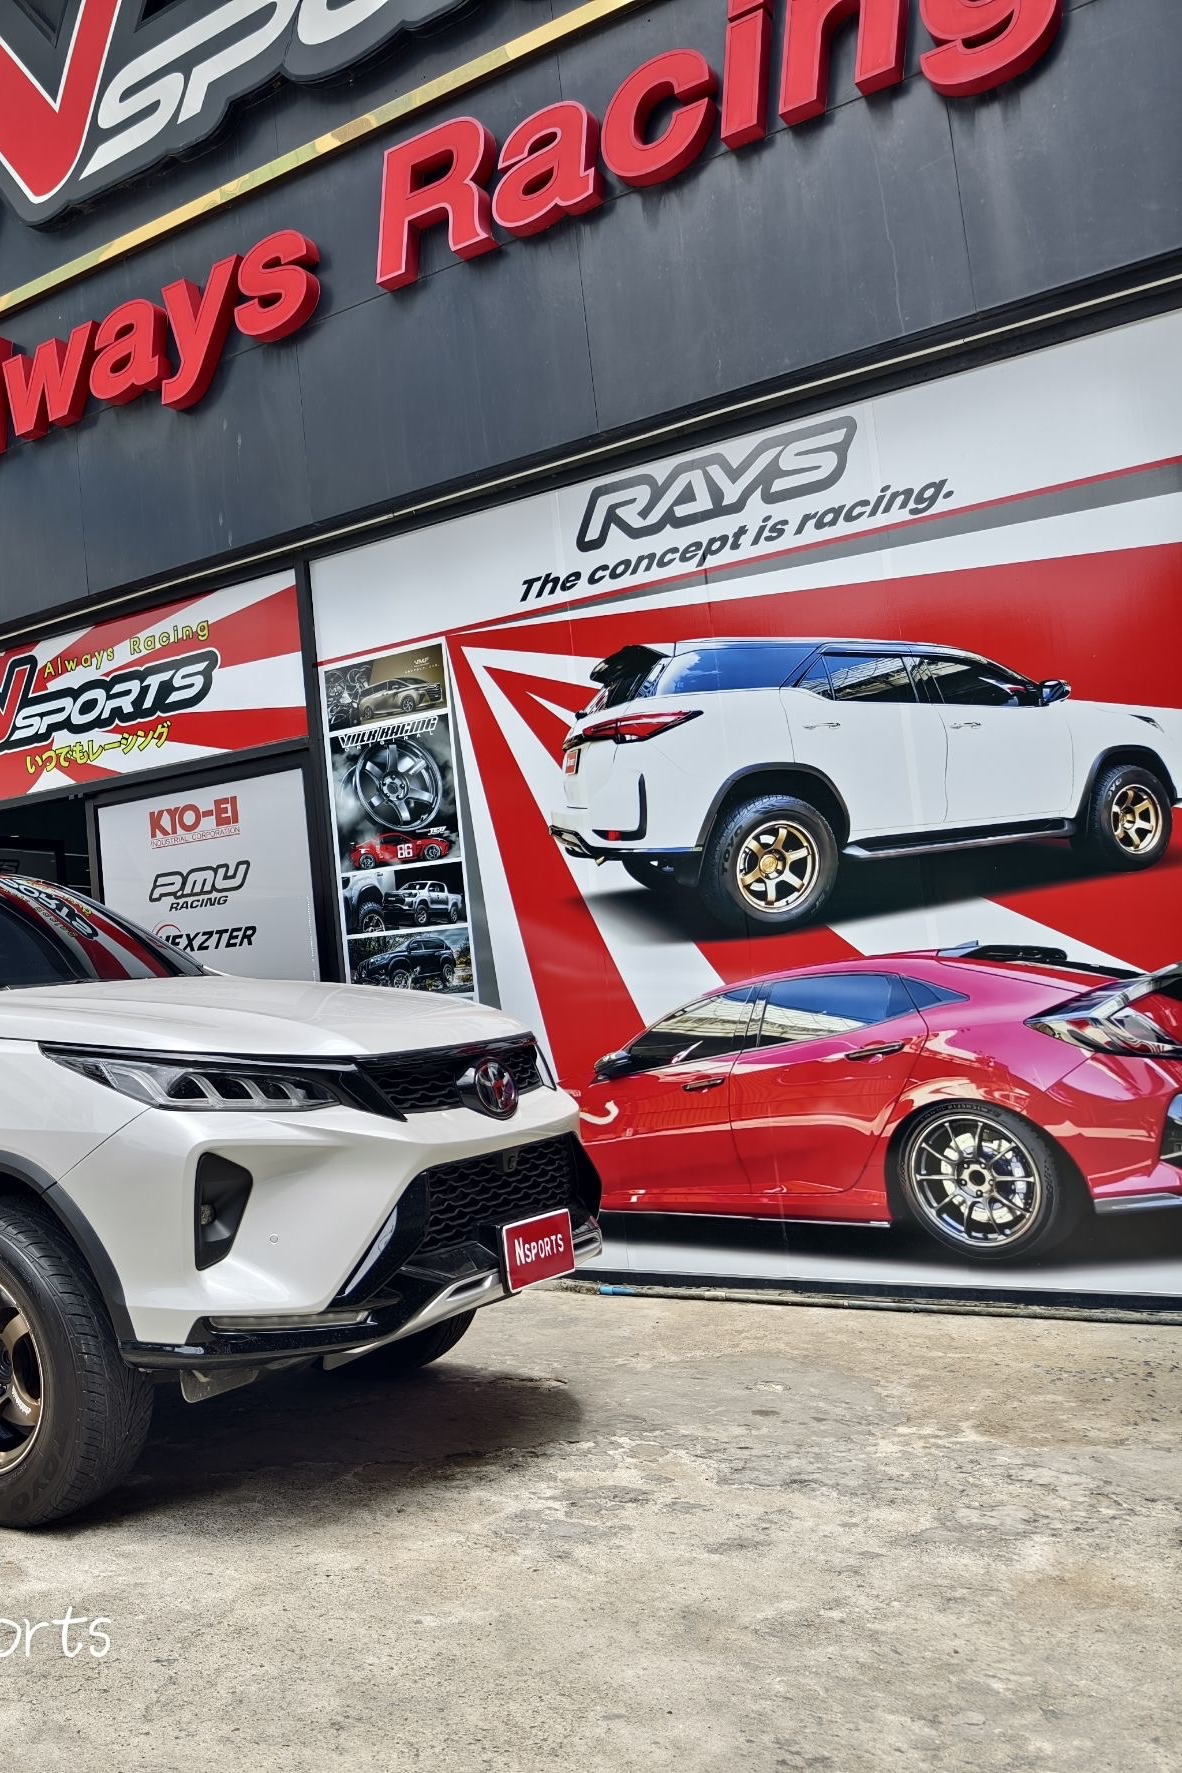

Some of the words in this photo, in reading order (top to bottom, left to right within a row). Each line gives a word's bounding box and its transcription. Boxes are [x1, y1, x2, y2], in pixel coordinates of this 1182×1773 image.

[576, 416, 858, 554] RAYS
[520, 574, 582, 603] The
[587, 524, 754, 587] concept
[750, 515, 787, 547] is
[793, 478, 955, 536] racing.
[43, 644, 114, 679] Always
[129, 620, 211, 655] Racing
[25, 721, 173, 774] いつでもレーシング
[149, 795, 239, 839] KYO-EI
[150, 836, 189, 848] INDUSTRIAL
[191, 826, 241, 841] CORPORATION
[396, 843, 413, 859] 86
[168, 895, 228, 912] RACING
[513, 1233, 565, 1267] NSPORTS
